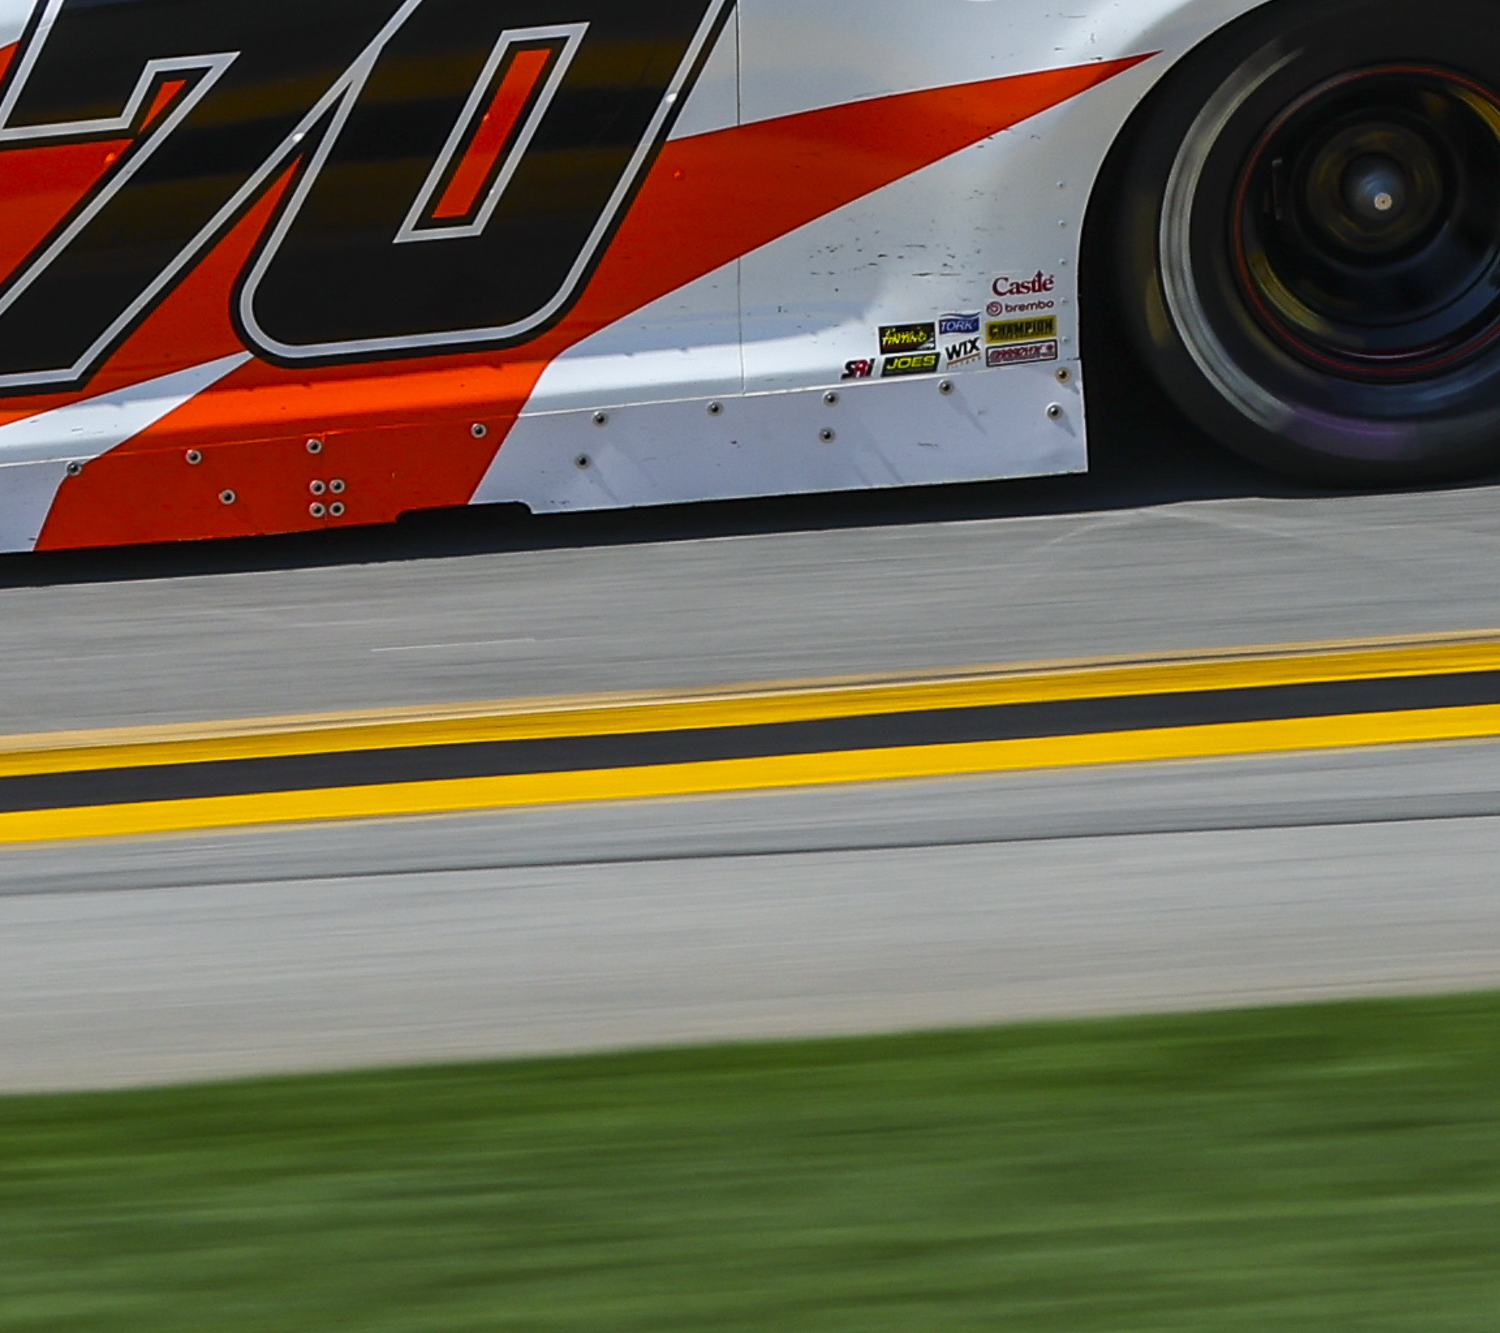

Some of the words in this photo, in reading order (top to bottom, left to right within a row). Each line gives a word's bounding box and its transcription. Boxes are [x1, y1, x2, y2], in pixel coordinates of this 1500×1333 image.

[992, 270, 1055, 297] Castle
[1005, 300, 1055, 313] brembo
[945, 337, 981, 361] WIX
[887, 355, 937, 370] JOES
